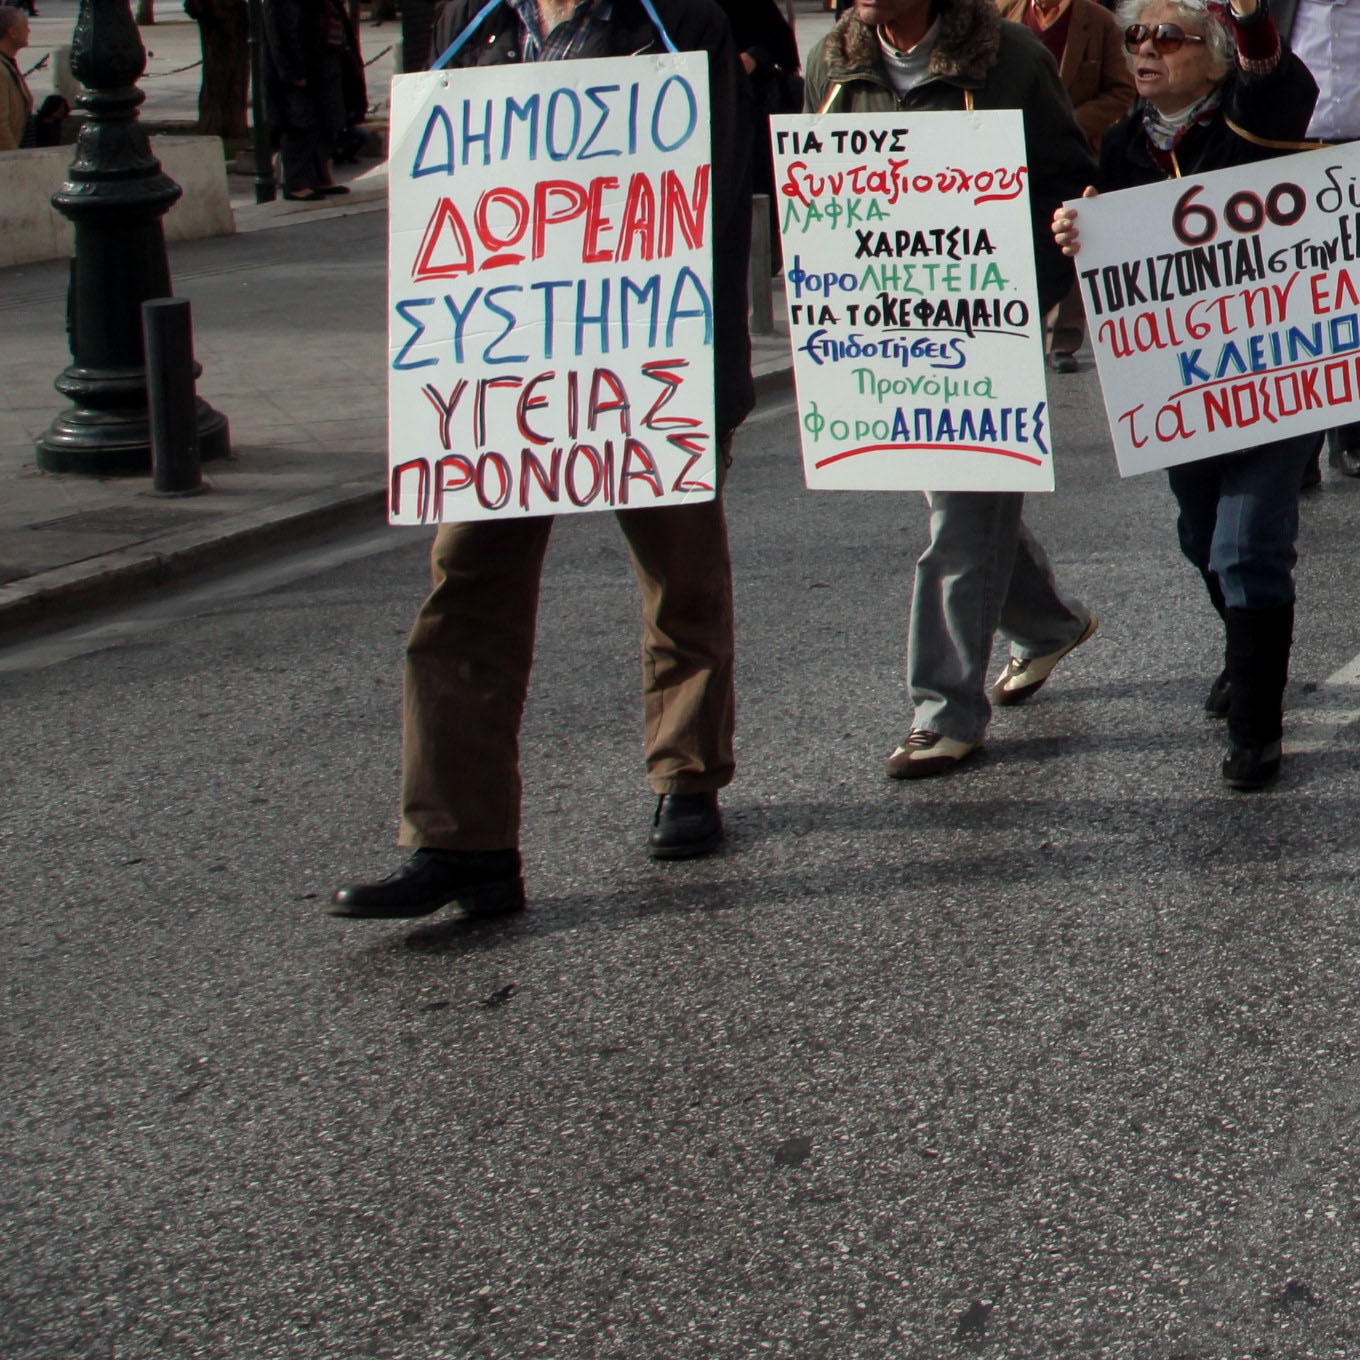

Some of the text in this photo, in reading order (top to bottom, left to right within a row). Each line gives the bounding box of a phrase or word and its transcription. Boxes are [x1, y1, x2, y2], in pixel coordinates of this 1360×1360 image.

[412, 75, 698, 179] ΔΗΜΟΣΙΟ
[777, 128, 909, 155] ΓΙΑ ΤΟΥΣ
[412, 164, 711, 282] ΔΩΡΕΑΝ
[854, 226, 997, 260] ΧΑΡΑΤΣΙΑ
[1172, 182, 1307, 246] 600
[790, 303, 842, 326] ΓΙΑ
[1081, 234, 1266, 315] ΤΟΚΙΖΟΝΤΑΙ
[392, 266, 713, 370] ΣΥΣΤΗΜΑ
[421, 358, 703, 450] ΥΓΕΙΑΣ
[391, 433, 714, 525] ΠΡΟΝΟΙΑΣ
